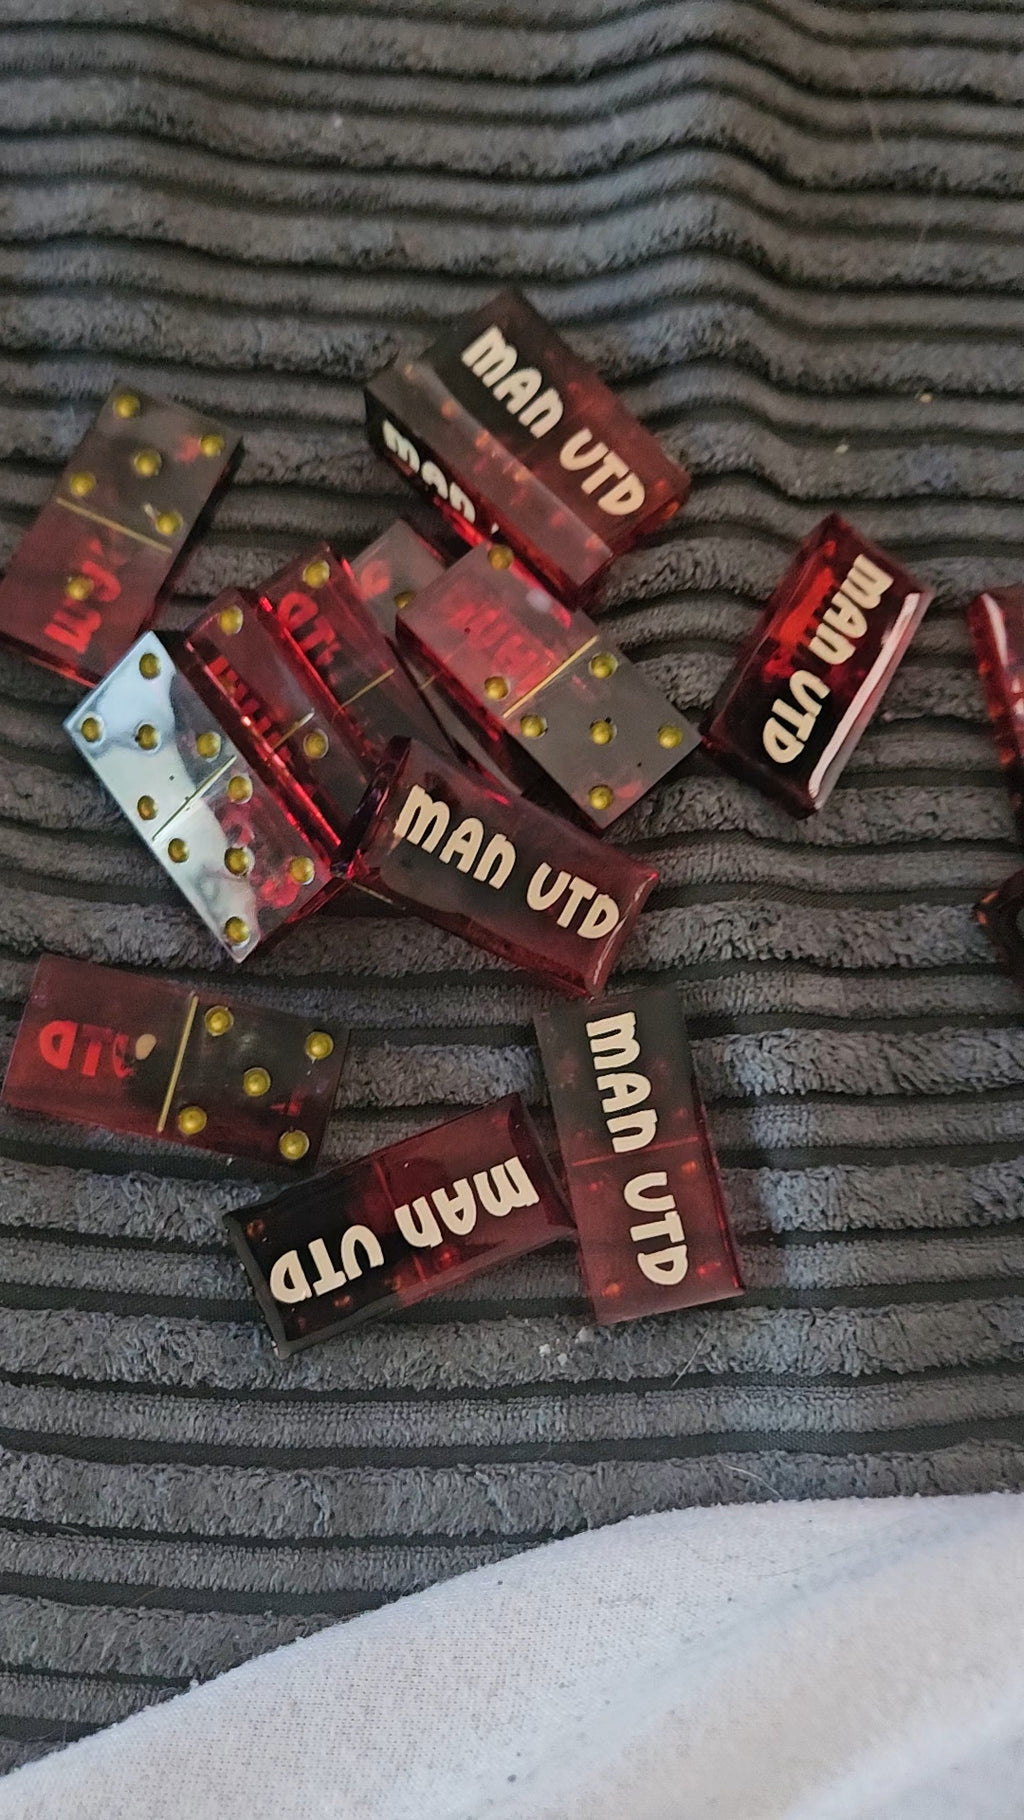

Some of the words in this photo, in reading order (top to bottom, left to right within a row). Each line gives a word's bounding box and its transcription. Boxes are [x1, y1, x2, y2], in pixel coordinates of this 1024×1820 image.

[461, 326, 563, 438] MAN
[560, 428, 645, 515] UTD
[809, 554, 894, 665] MAN
[763, 669, 831, 764] UTD
[393, 784, 516, 889] MAN
[526, 862, 620, 939] UTD
[395, 1156, 539, 1248] MAN
[586, 1011, 658, 1153] MAN
[624, 1171, 689, 1286] UTD
[269, 1224, 385, 1304] UTD
